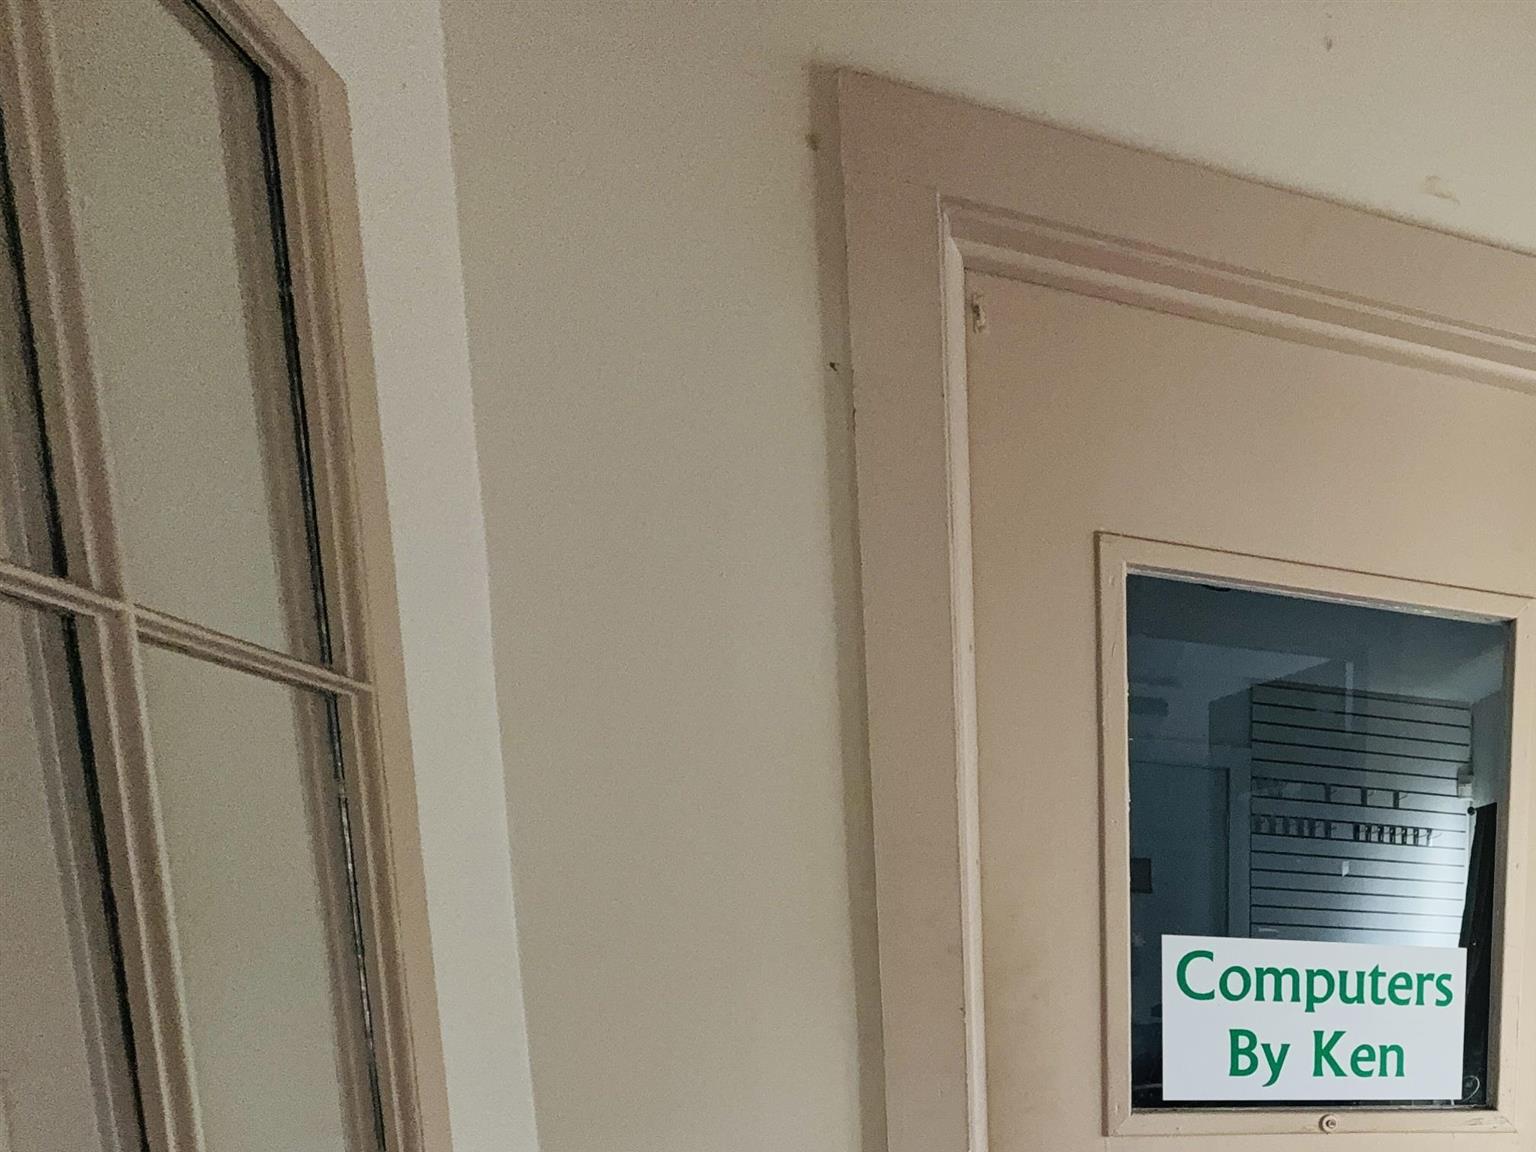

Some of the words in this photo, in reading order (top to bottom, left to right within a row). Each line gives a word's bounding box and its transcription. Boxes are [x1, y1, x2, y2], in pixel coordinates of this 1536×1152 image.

[1175, 949, 1454, 1013] Computers
[1228, 1028, 1291, 1087] By
[1312, 1029, 1406, 1078] Ken
